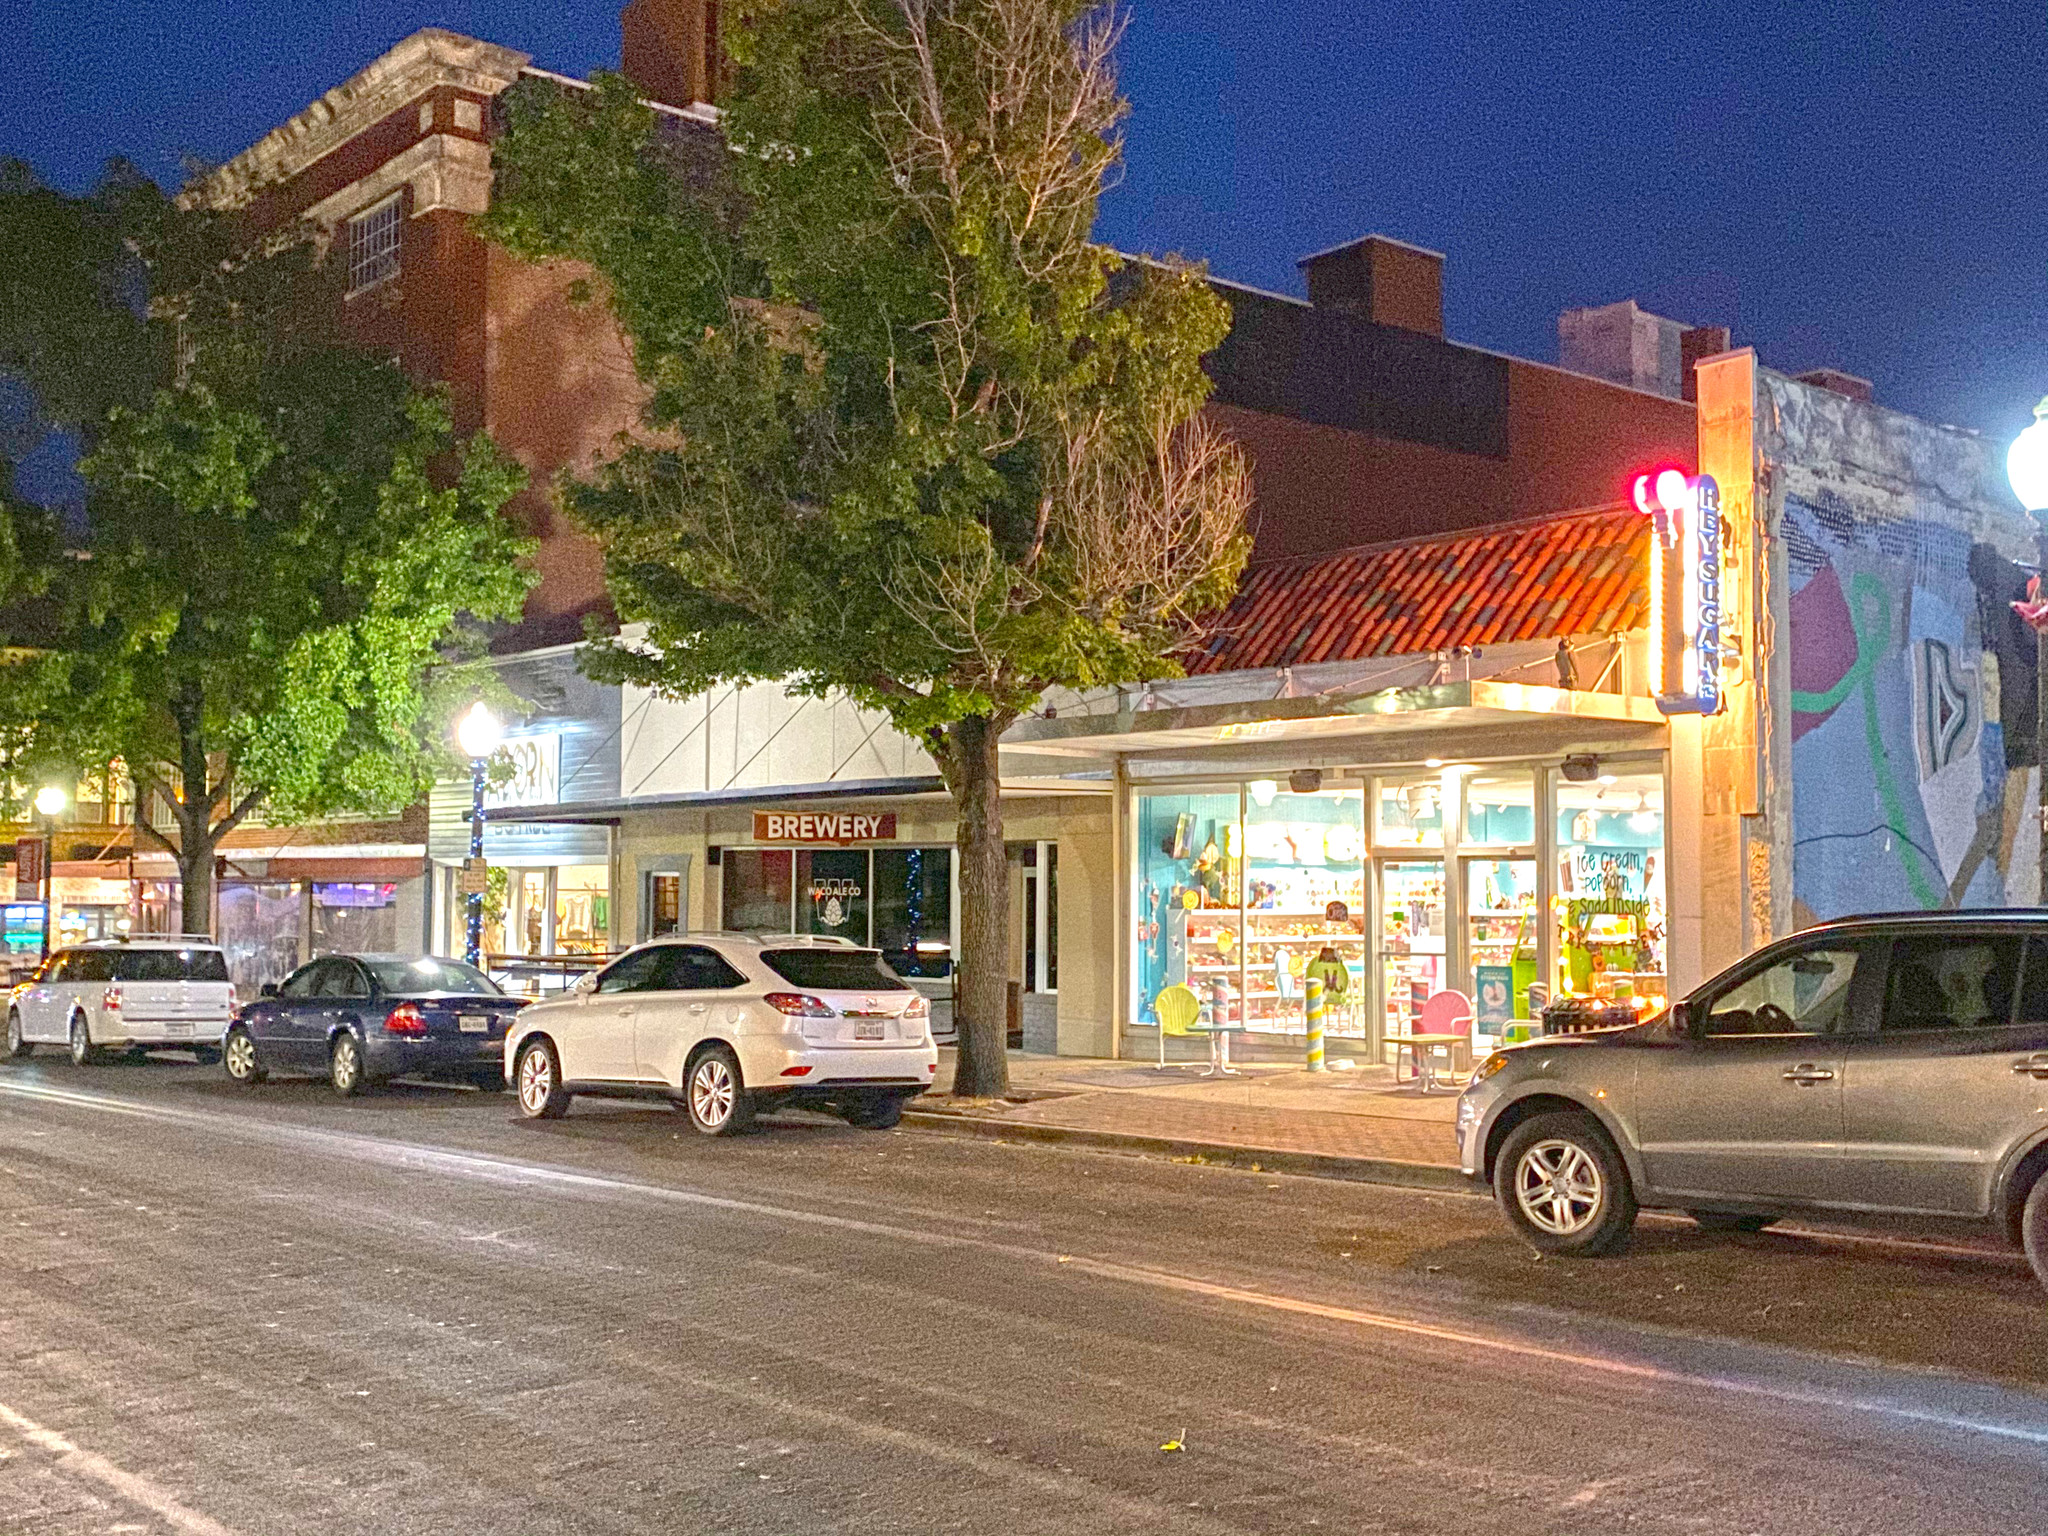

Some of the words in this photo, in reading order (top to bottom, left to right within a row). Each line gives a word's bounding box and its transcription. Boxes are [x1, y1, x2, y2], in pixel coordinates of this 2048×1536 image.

[767, 815, 882, 838] BREWERY
[1577, 851, 1596, 875] ice
[807, 886, 832, 896] WACO
[832, 886, 847, 896] ALE
[848, 886, 861, 896] CO
[1613, 894, 1650, 917] inside
